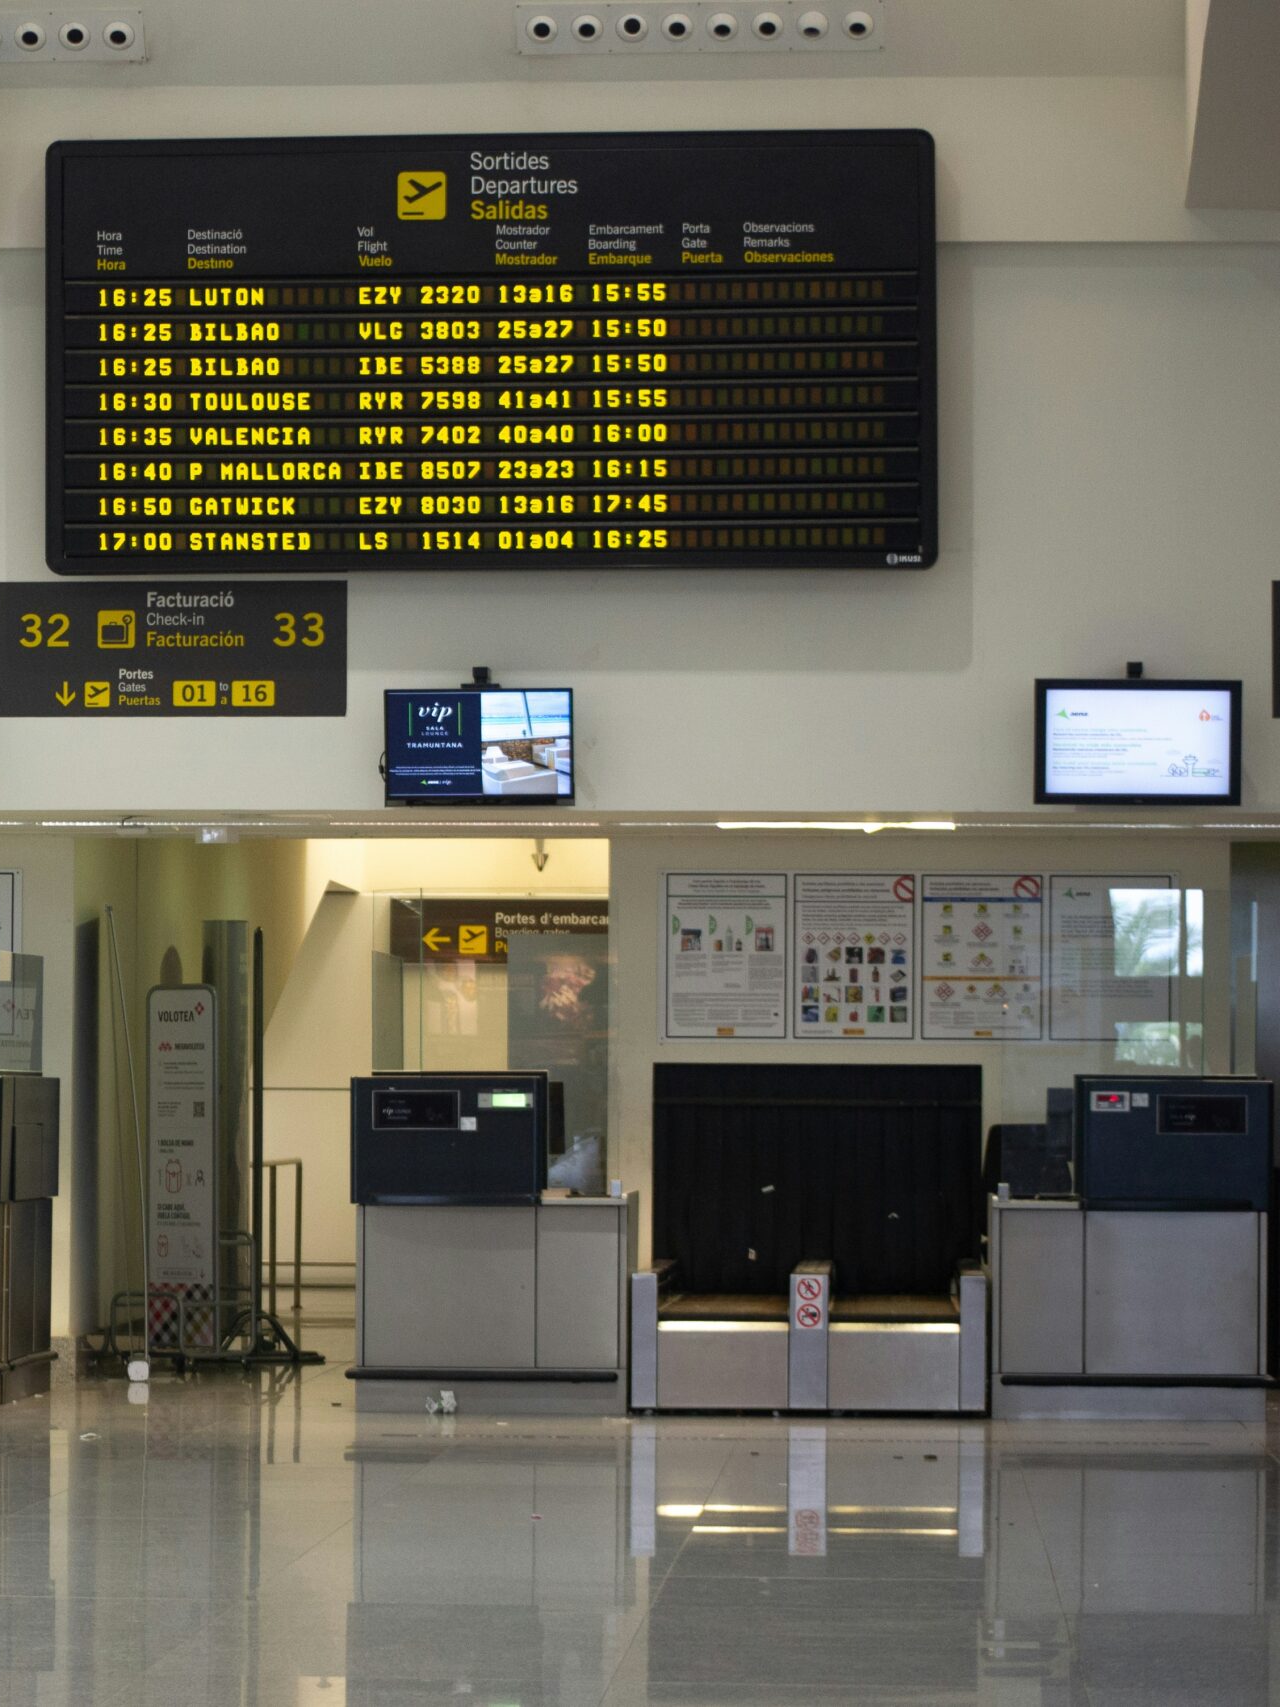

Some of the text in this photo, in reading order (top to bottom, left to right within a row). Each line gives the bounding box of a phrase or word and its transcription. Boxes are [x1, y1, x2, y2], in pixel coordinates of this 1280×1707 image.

[471, 152, 549, 170] Sortides
[472, 176, 577, 198] Departures
[471, 200, 547, 220] Salidas
[357, 227, 373, 237] Vol
[496, 224, 550, 235] Mostrador
[589, 224, 663, 235] Embarcament
[683, 223, 710, 233] Porta
[743, 222, 814, 233] Observacions
[97, 231, 122, 241] Hora
[188, 229, 242, 240] Destinació
[358, 241, 387, 254] Flight
[496, 239, 537, 249] Counter
[589, 239, 636, 251] Boarding
[682, 237, 707, 248] Gate
[744, 237, 790, 247] Remarks
[97, 245, 122, 255] Time
[188, 244, 246, 254] Destination
[188, 257, 233, 269] Destino
[359, 255, 392, 266] Vuelo
[496, 253, 557, 265] Mostrador
[589, 253, 652, 266] Embarque
[682, 252, 722, 263] Puerta
[744, 251, 834, 263] Observaciones
[97, 259, 125, 270] Hora
[100, 283, 665, 306] 16:25 LUTON EZY 2320 13a16 15:55
[100, 389, 666, 411] 16:30 TOULOUSE RYR 7598 41a41 15:55
[100, 460, 666, 480] 16:40 P MALLORCA IBE 8507 23a23 16:15
[100, 530, 667, 550] 17:00 STANSTED LS 1514 01a04 16:25
[147, 591, 234, 607] Facturació
[147, 613, 204, 625] Check-in
[20, 614, 69, 647] 32
[273, 613, 324, 646] 33
[147, 631, 244, 647] Facturación
[119, 669, 153, 679] Portes
[118, 682, 146, 692] Gates
[220, 682, 228, 691] to
[182, 684, 206, 702] 01
[243, 684, 267, 702] 16
[119, 695, 160, 705] Puertas
[221, 696, 227, 704] a
[418, 702, 453, 722] vip
[495, 912, 608, 924] Portes d'embarca
